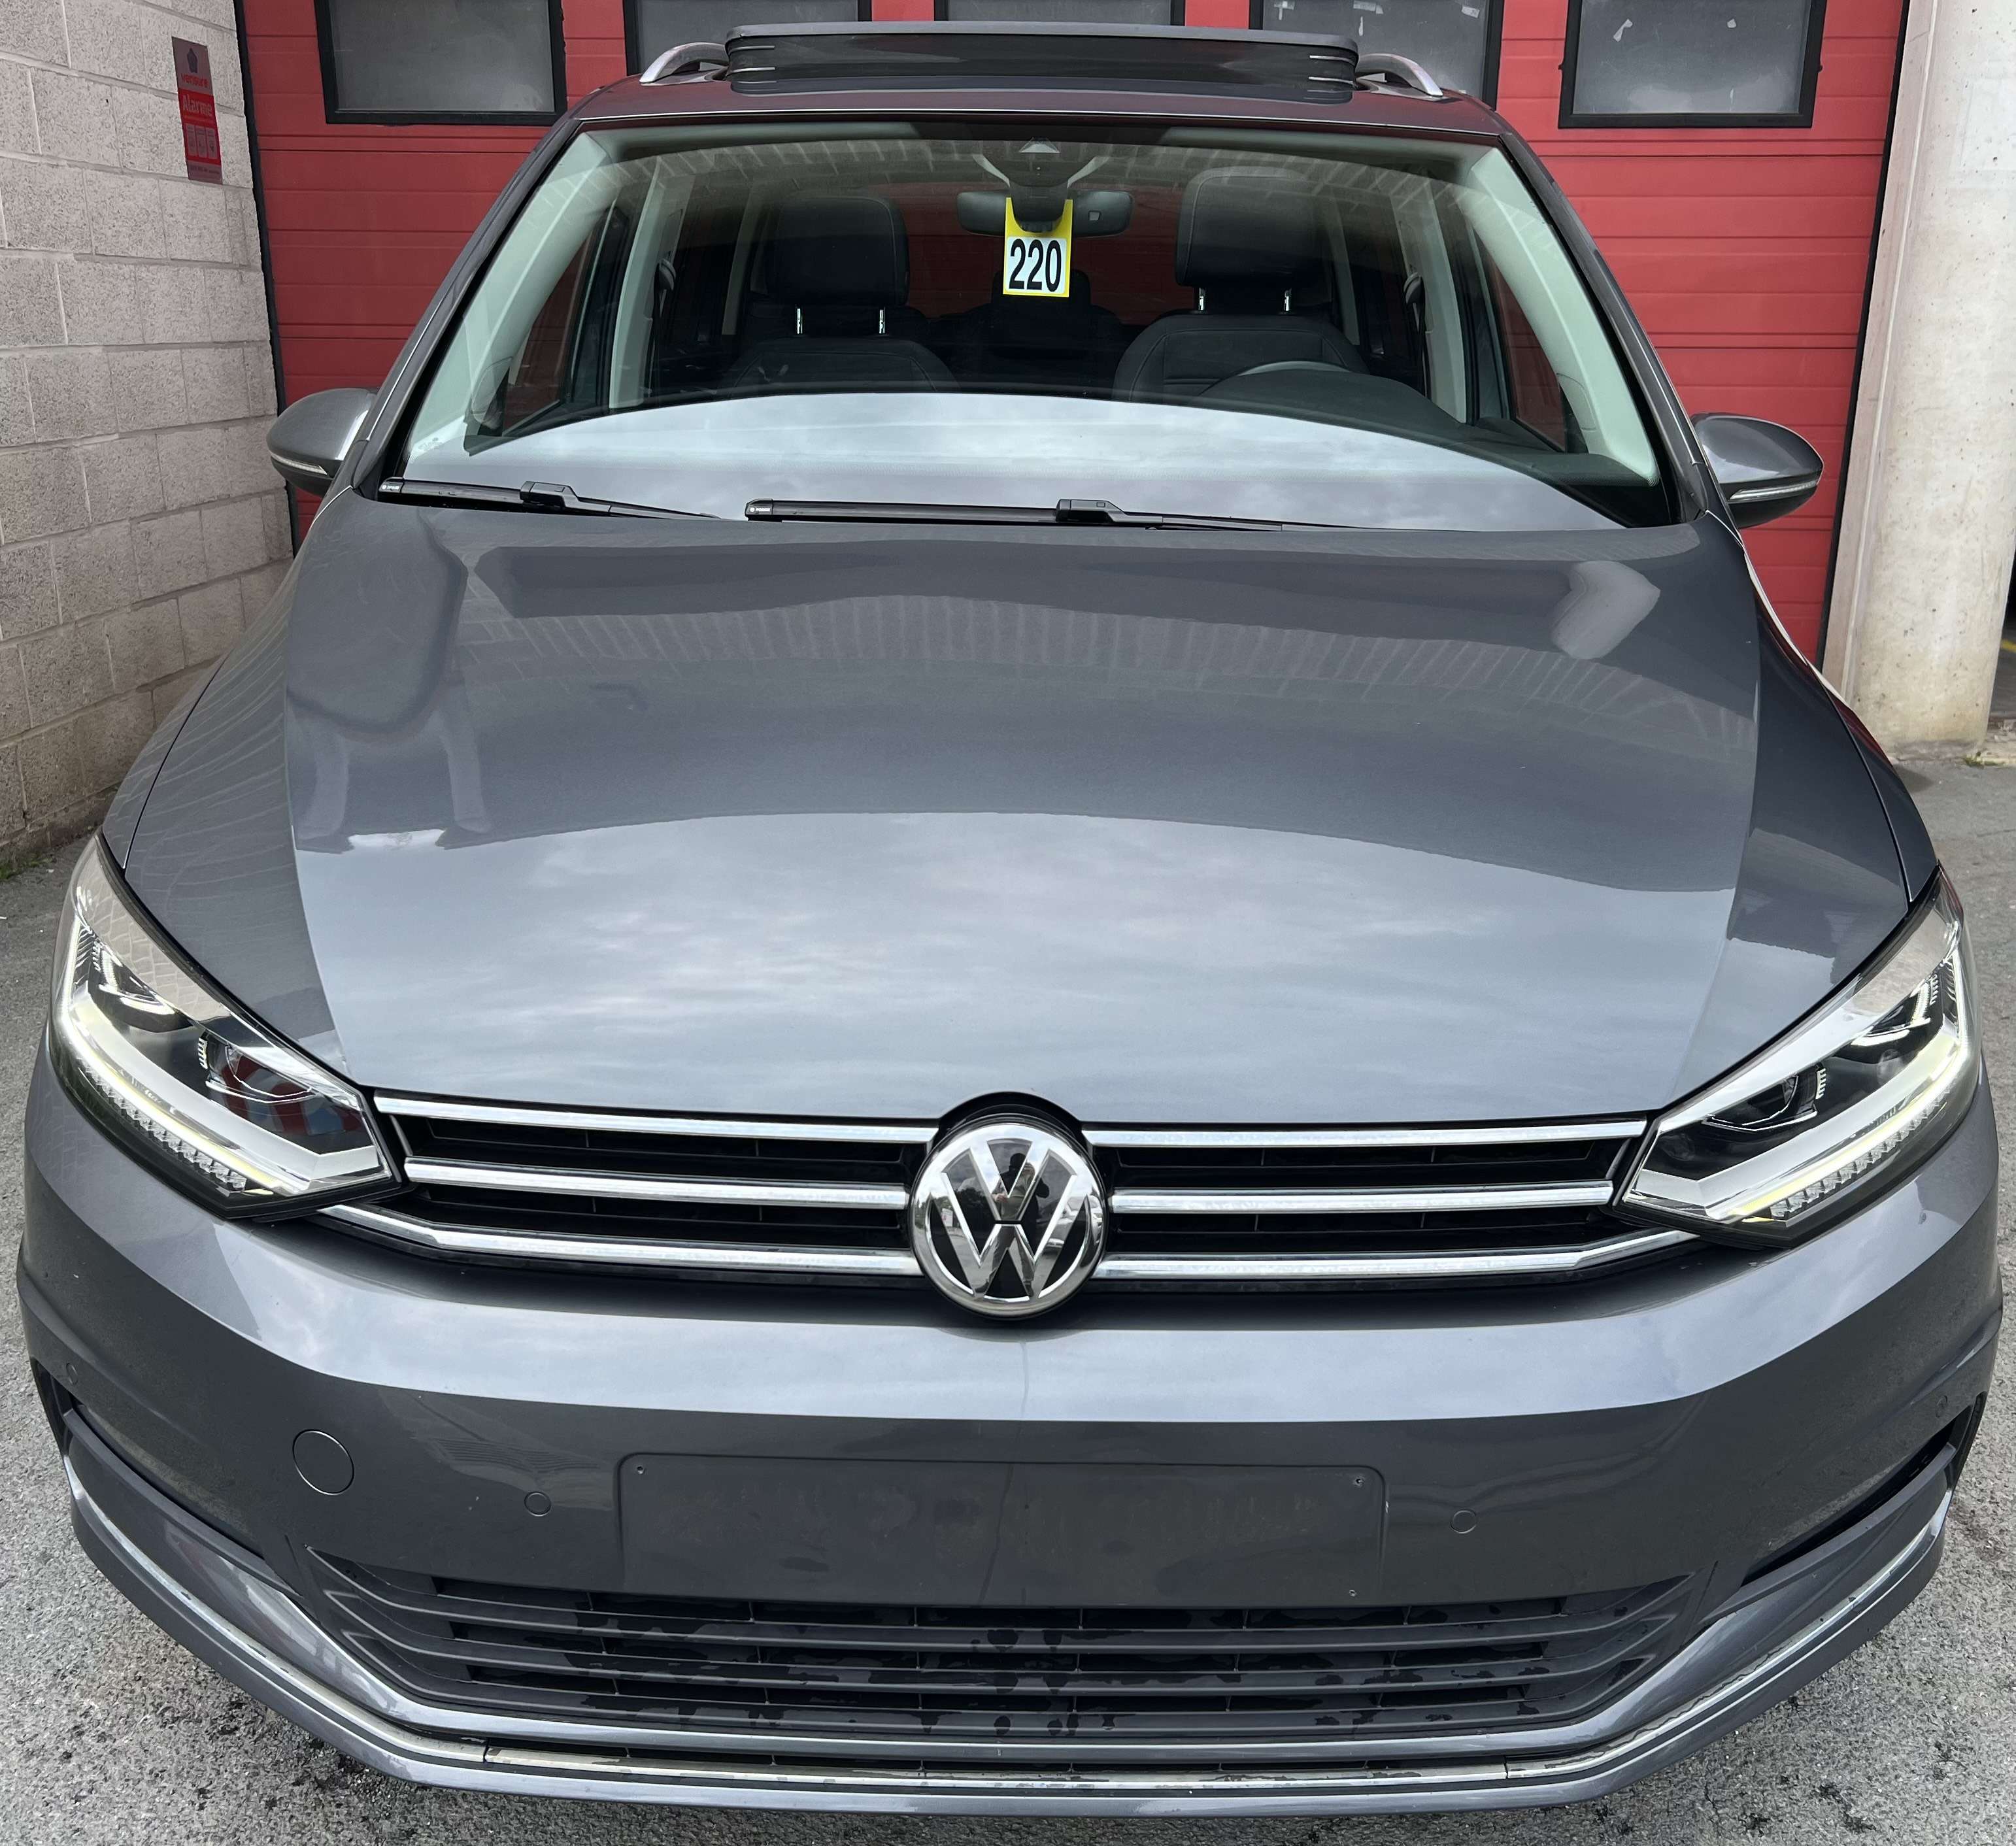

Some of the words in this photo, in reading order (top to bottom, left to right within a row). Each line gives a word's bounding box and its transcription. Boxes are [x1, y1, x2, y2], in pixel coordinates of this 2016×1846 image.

[182, 93, 212, 116] Alarme
[1009, 239, 1062, 292] 220
[922, 1122, 1092, 1304] VW
